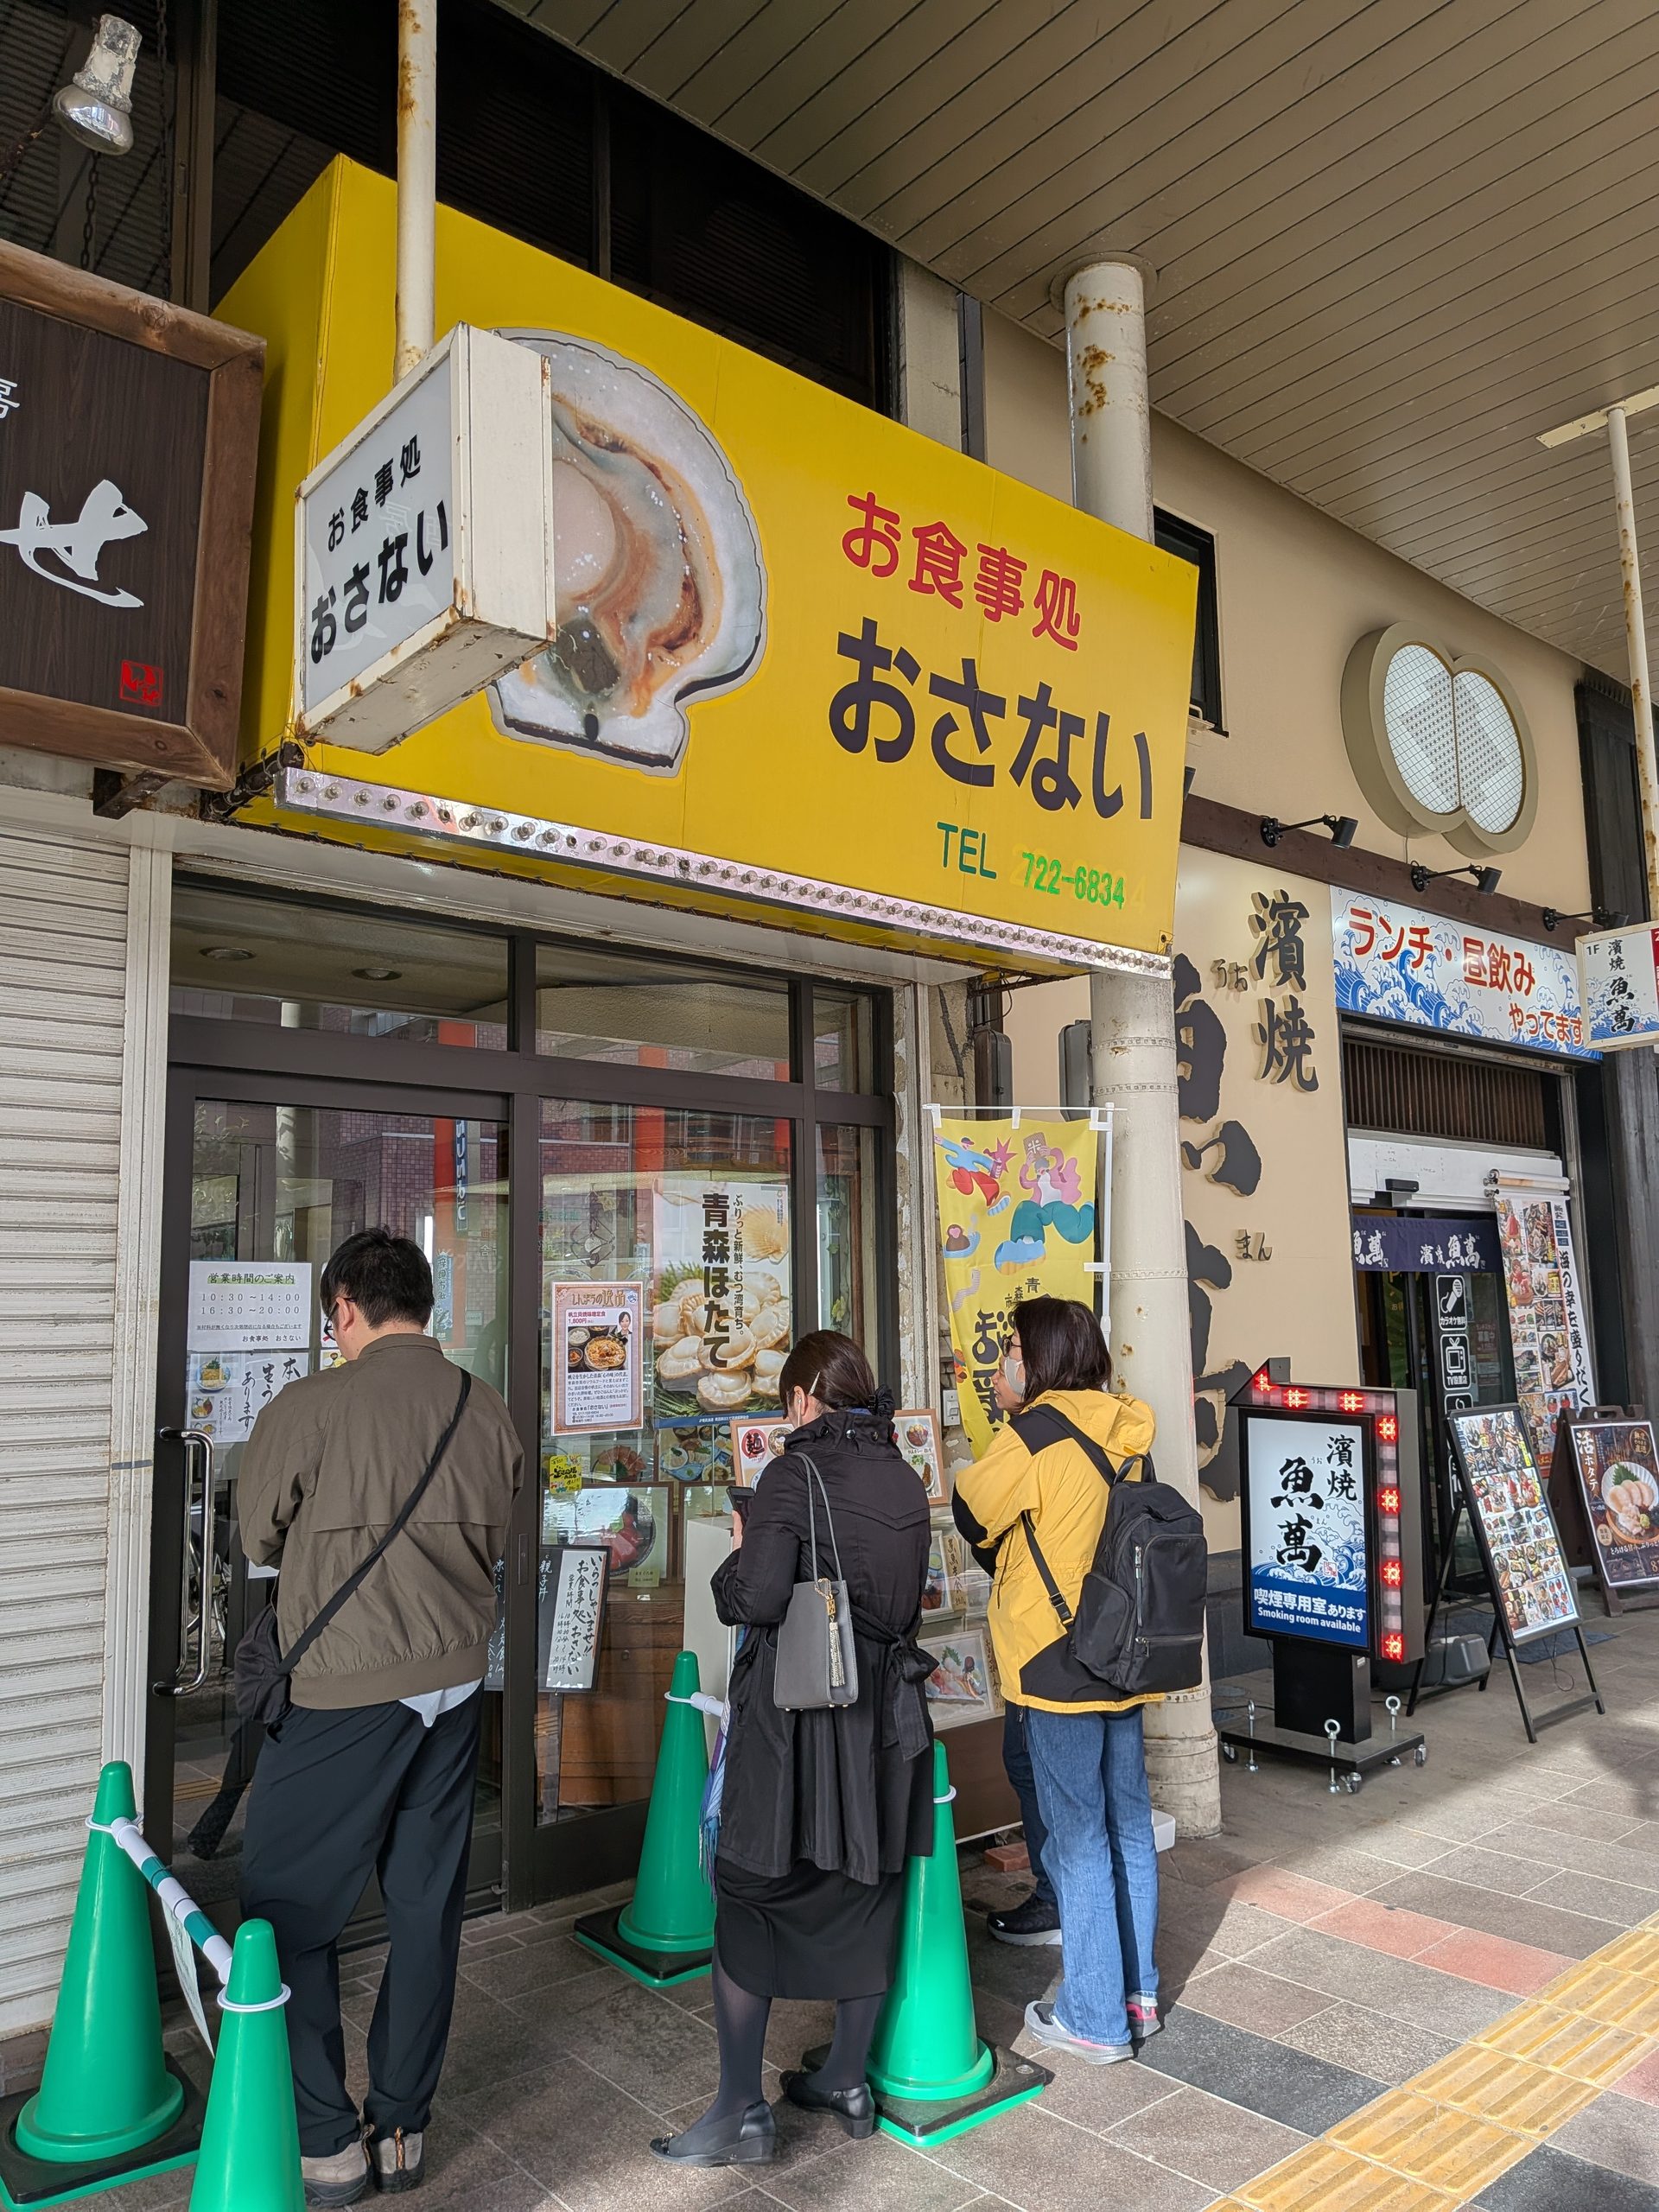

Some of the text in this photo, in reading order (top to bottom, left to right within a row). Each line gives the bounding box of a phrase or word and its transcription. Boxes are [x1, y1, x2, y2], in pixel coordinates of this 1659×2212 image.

[327, 435, 421, 552] お食事処
[311, 500, 448, 664] おさない
[842, 491, 1082, 652] お食事処
[829, 616, 1153, 820] おさない
[937, 822, 1125, 909] TEL 722-6834
[1211, 958, 1249, 992] うお
[1349, 906, 1536, 998] ランチ・昼飲み
[1586, 944, 1600, 955] 1F
[1249, 888, 1319, 1093] 濱焼
[1509, 1001, 1583, 1046] やってます
[208, 1273, 295, 1285] 営業時間のご案内
[702, 1192, 731, 1368] 青森ほたて
[1235, 1228, 1274, 1262] まん
[1326, 1434, 1357, 1501] 濱焼
[1576, 1430, 1599, 1492] 活ホタテ
[1270, 1457, 1324, 1573] 魚萬
[1254, 1588, 1366, 1622] 喫煙専用室あります
[1258, 1607, 1361, 1633] Smoking room available
